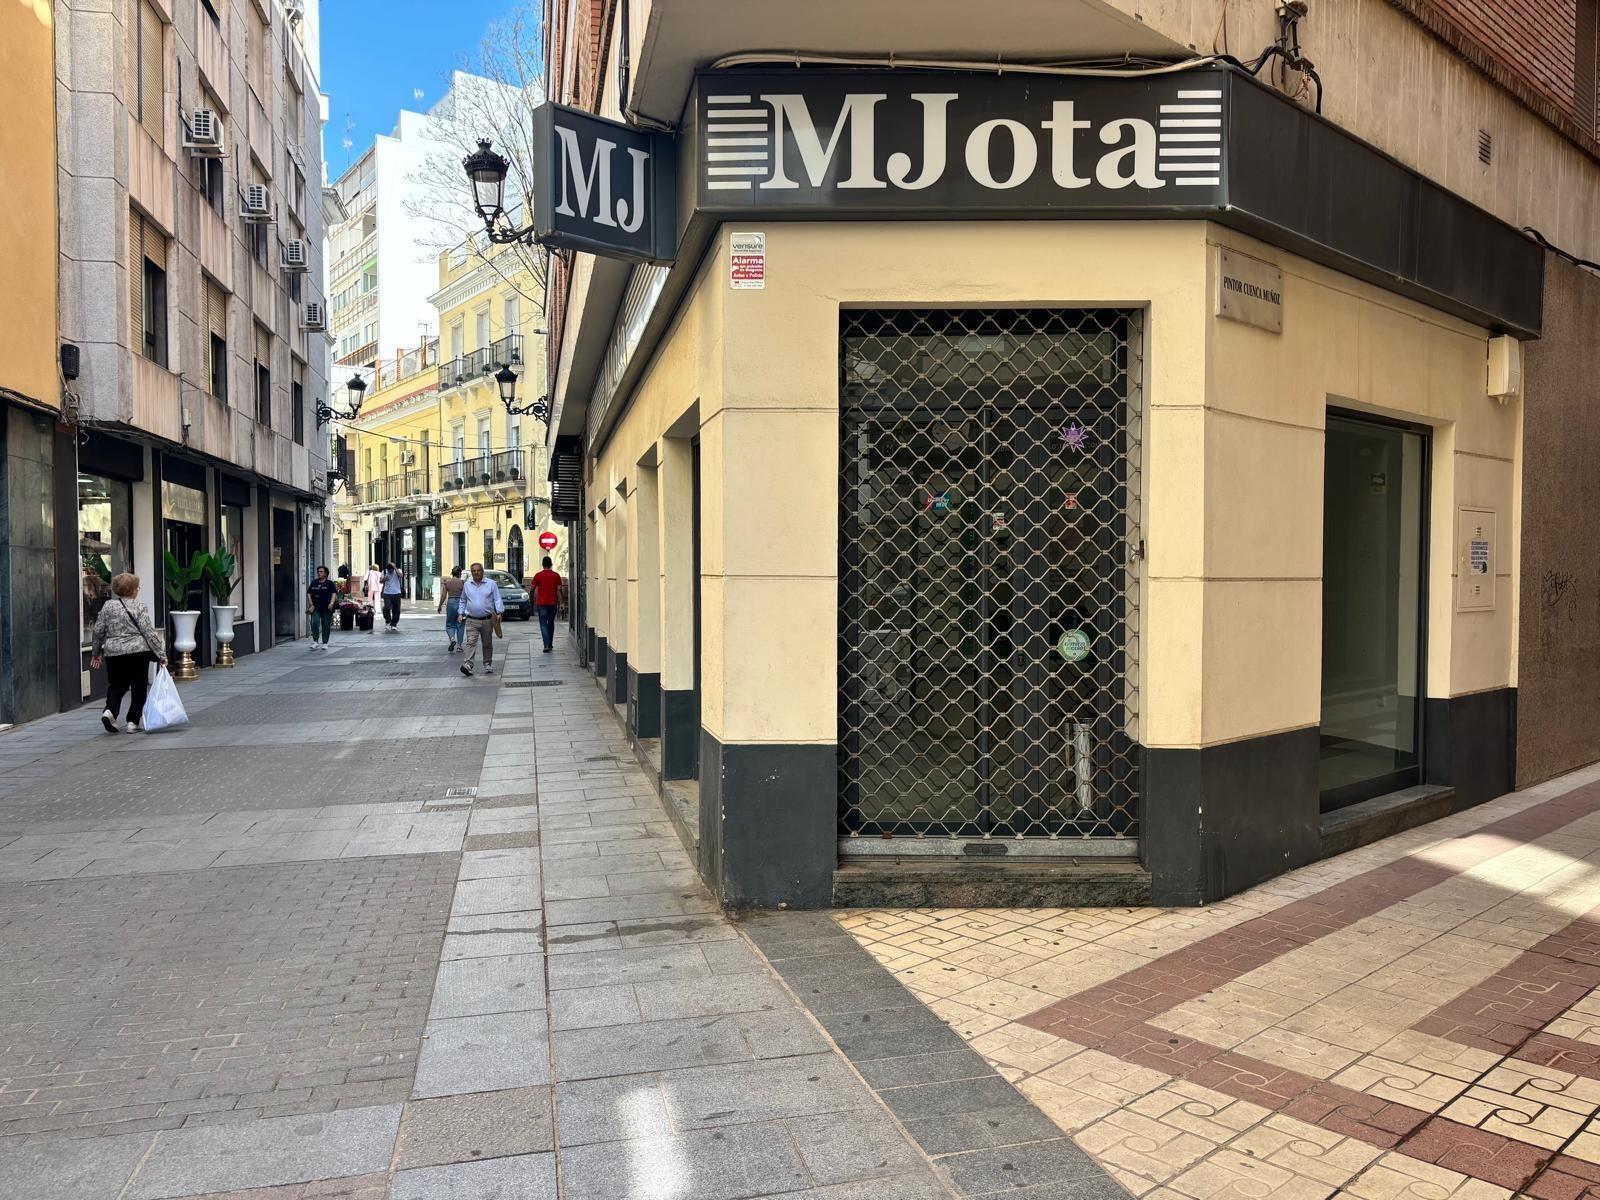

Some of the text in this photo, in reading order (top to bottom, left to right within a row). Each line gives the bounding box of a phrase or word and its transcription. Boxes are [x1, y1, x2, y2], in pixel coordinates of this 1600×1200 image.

[554, 125, 651, 233] MJ
[760, 92, 1166, 191] MJota
[1223, 276, 1280, 305] PINTOR CUENCA MUÑOZ
